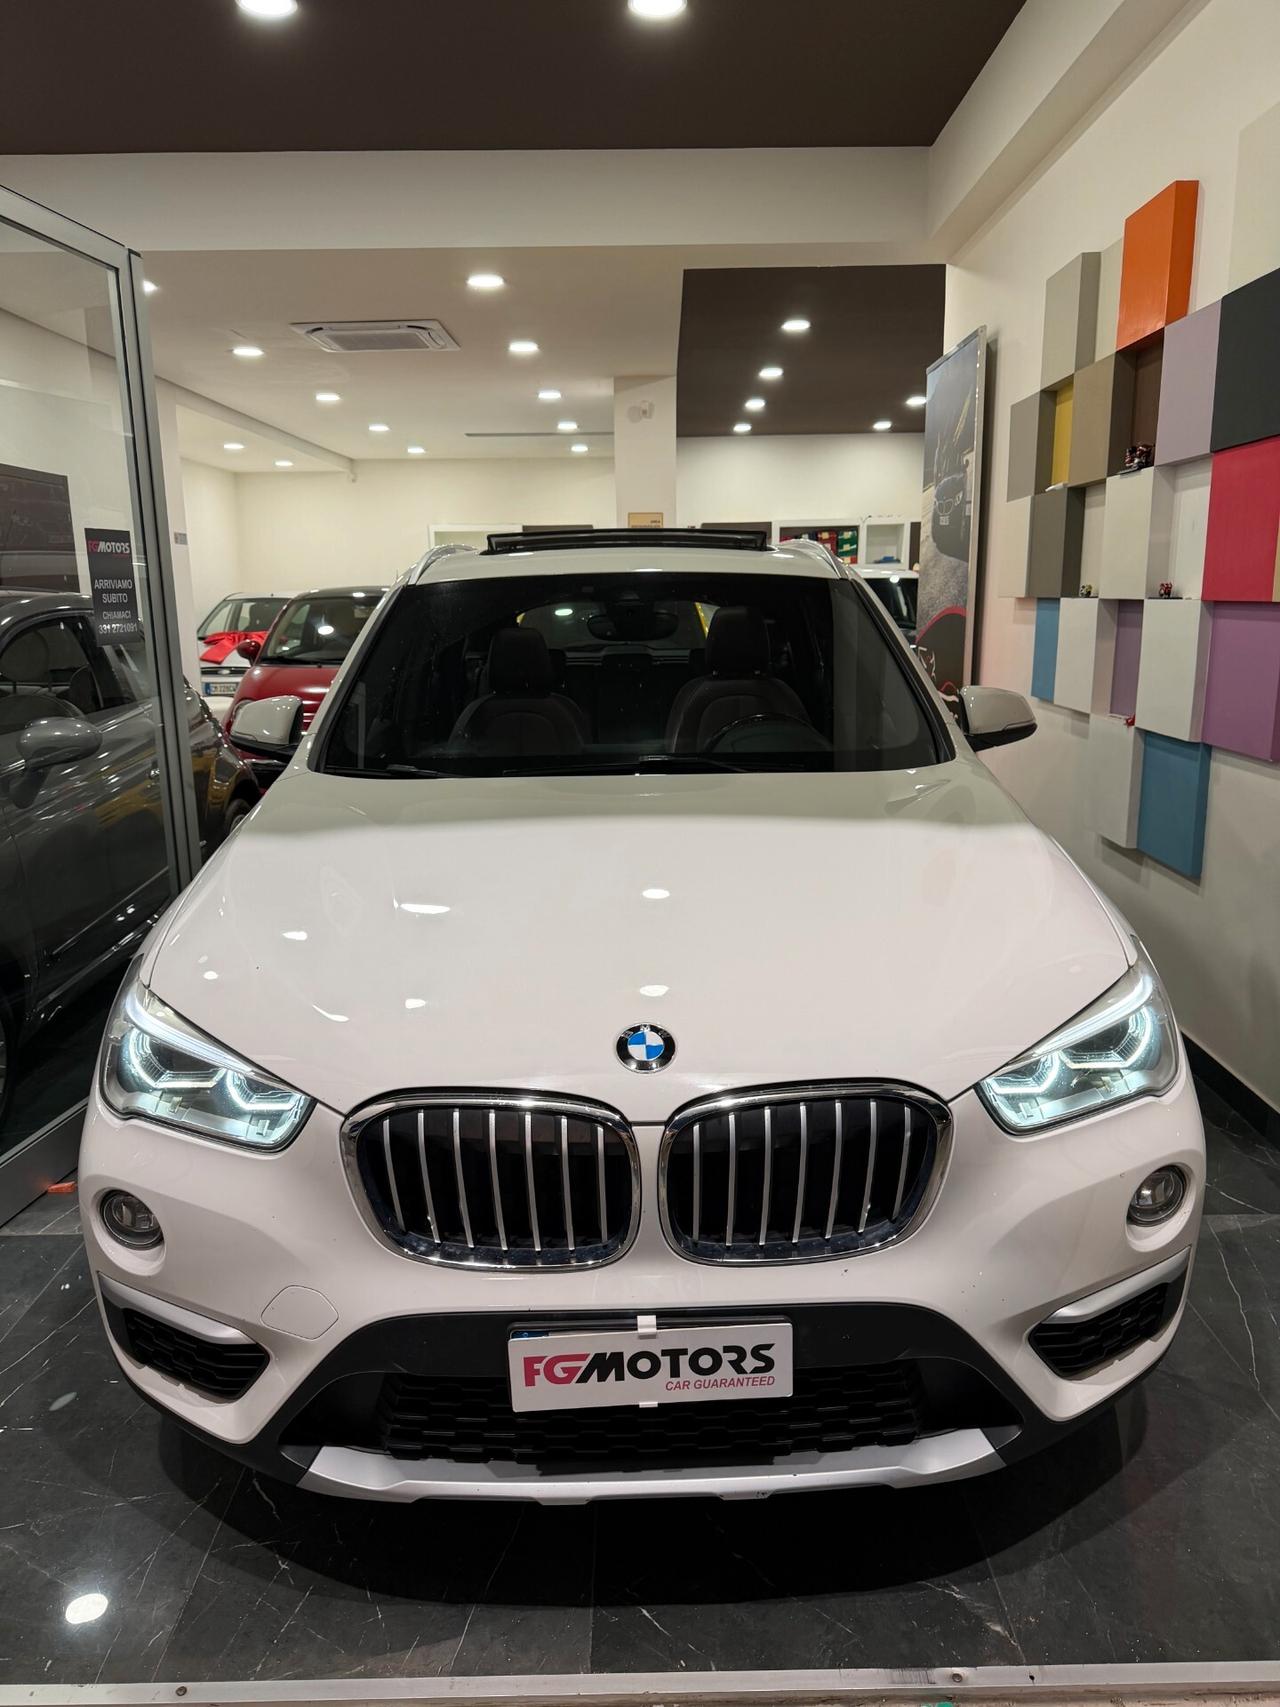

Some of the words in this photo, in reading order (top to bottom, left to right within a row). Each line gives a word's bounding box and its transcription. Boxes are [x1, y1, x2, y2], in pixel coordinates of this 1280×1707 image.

[88, 541, 130, 554] FGMOTORS
[94, 579, 133, 589] ARRIVIAMO
[102, 593, 128, 603] SUBITO
[102, 611, 131, 620] CHIAMACI
[523, 1343, 775, 1387] FGMOTORS
[665, 1378, 690, 1391] CAR
[693, 1375, 775, 1390] GUARANTEED
